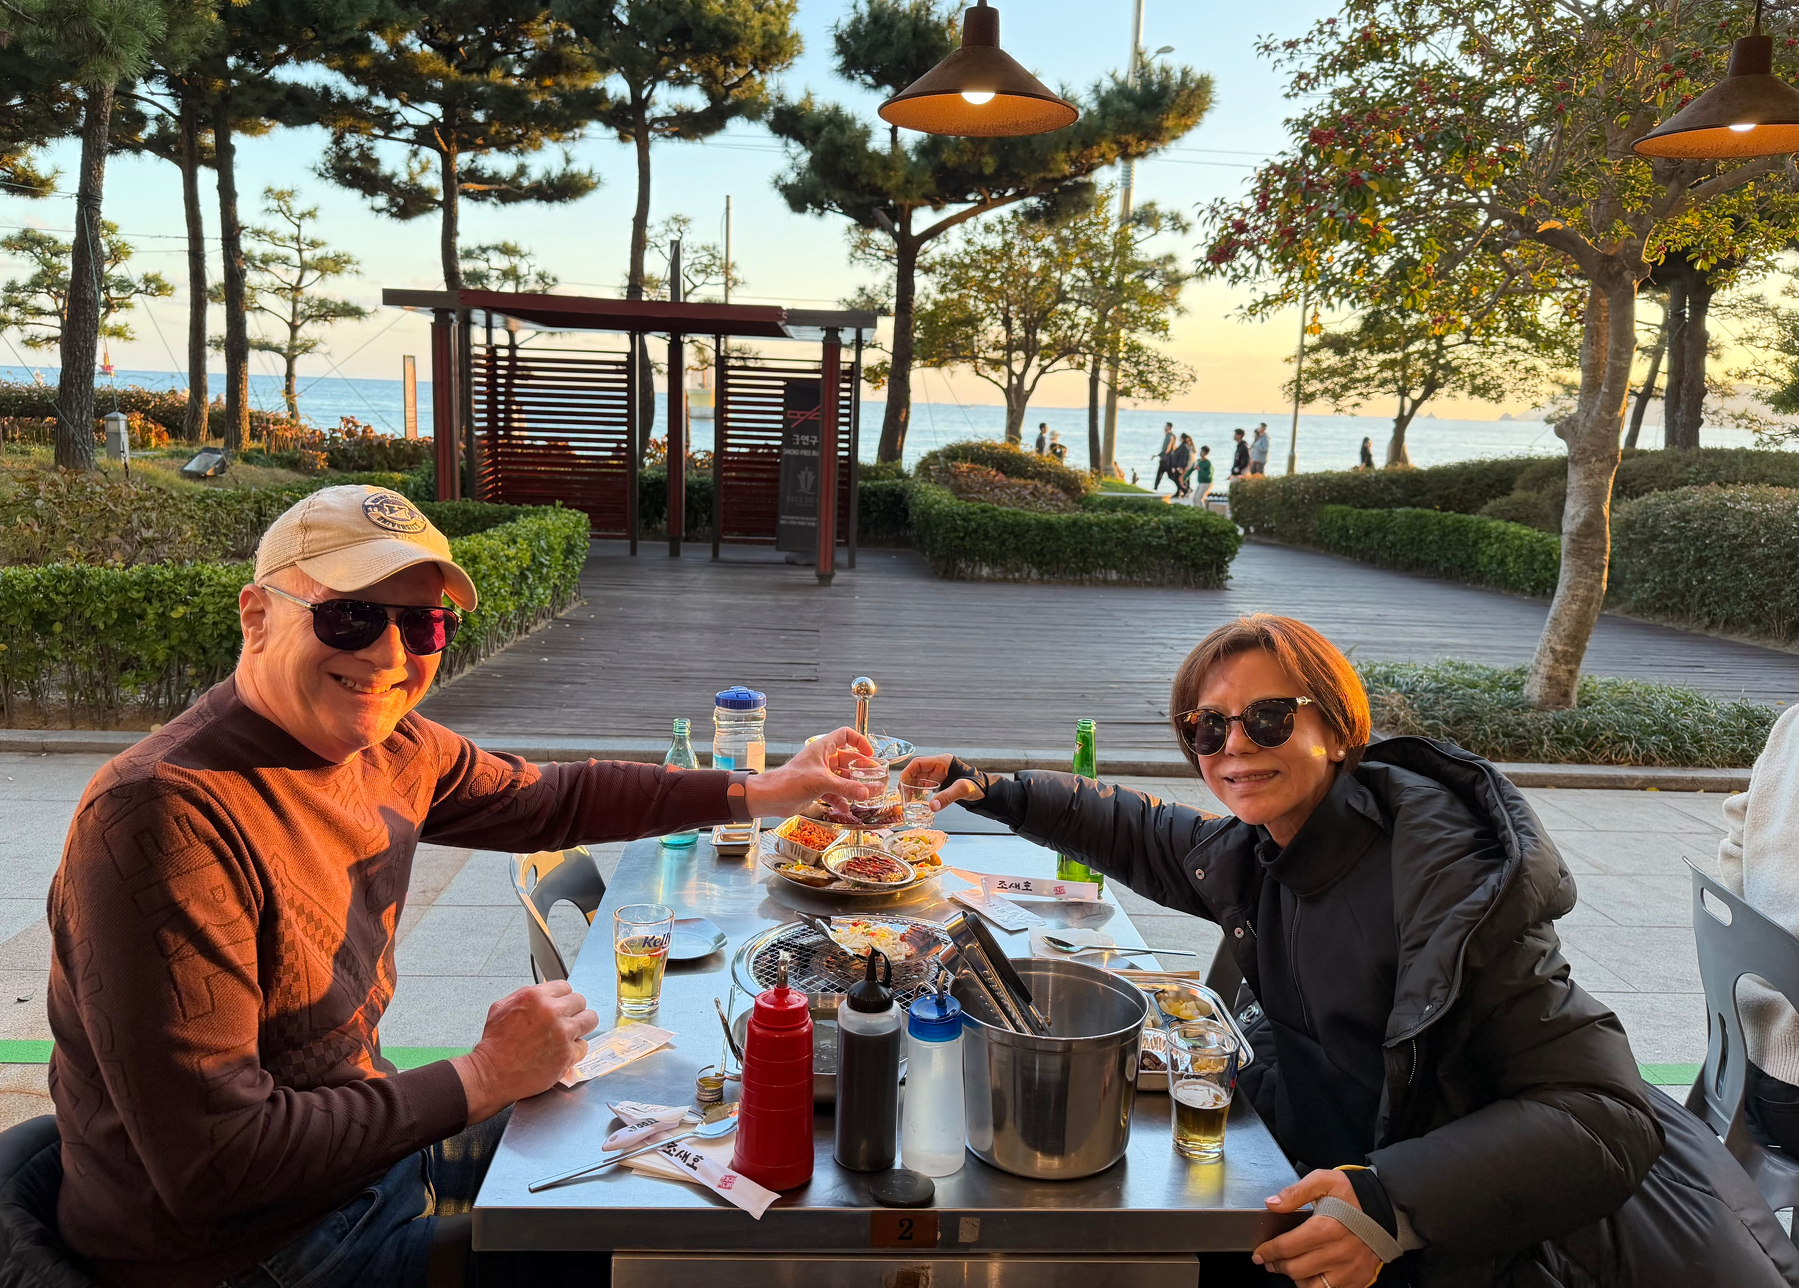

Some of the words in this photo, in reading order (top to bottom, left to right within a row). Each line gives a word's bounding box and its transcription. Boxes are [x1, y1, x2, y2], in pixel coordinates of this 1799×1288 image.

[791, 434, 819, 446] 금연구
[996, 880, 1033, 892] 조새호
[897, 1217, 914, 1241] 2
